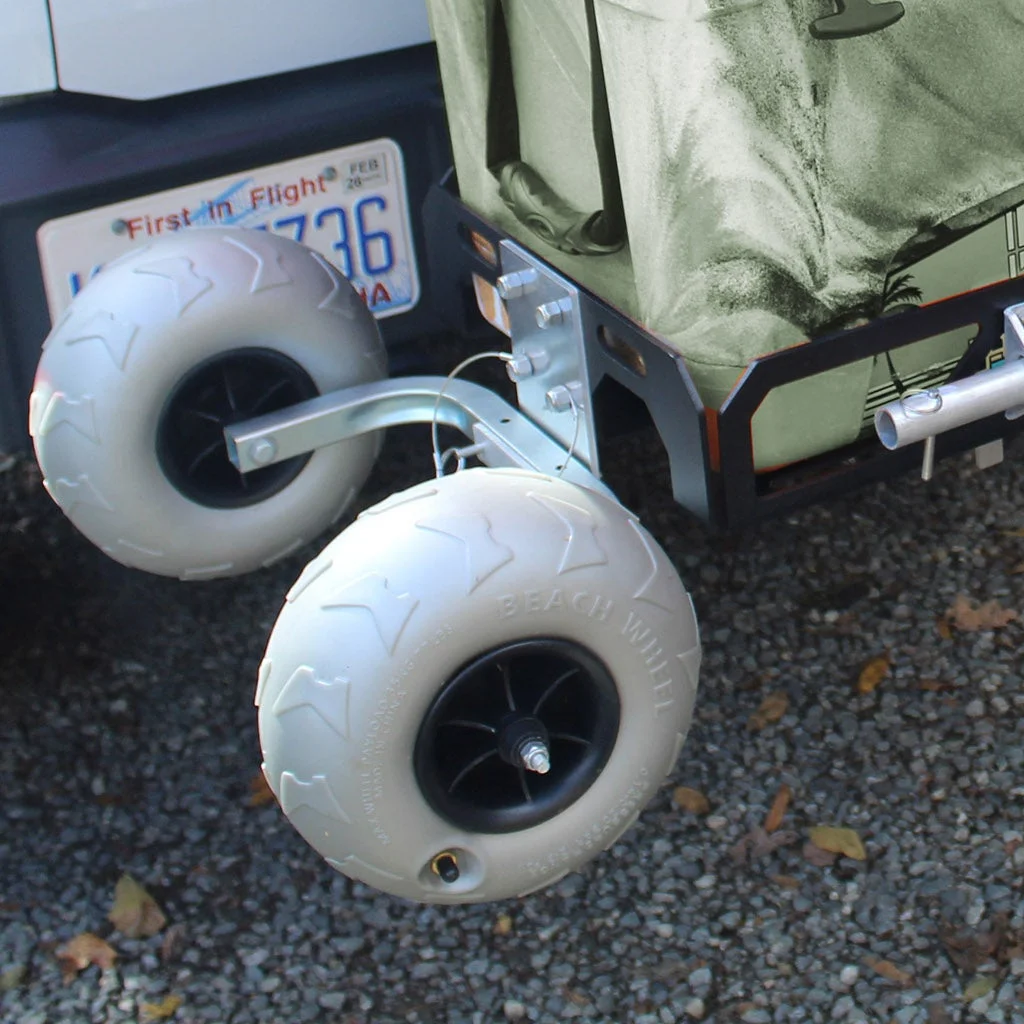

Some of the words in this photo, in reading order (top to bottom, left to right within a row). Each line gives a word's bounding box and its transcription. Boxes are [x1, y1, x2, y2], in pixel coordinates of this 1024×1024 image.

[349, 159, 379, 175] FEB
[126, 207, 191, 240] First
[207, 199, 233, 220] in
[250, 174, 327, 210] Flight
[497, 587, 614, 620] BEACH
